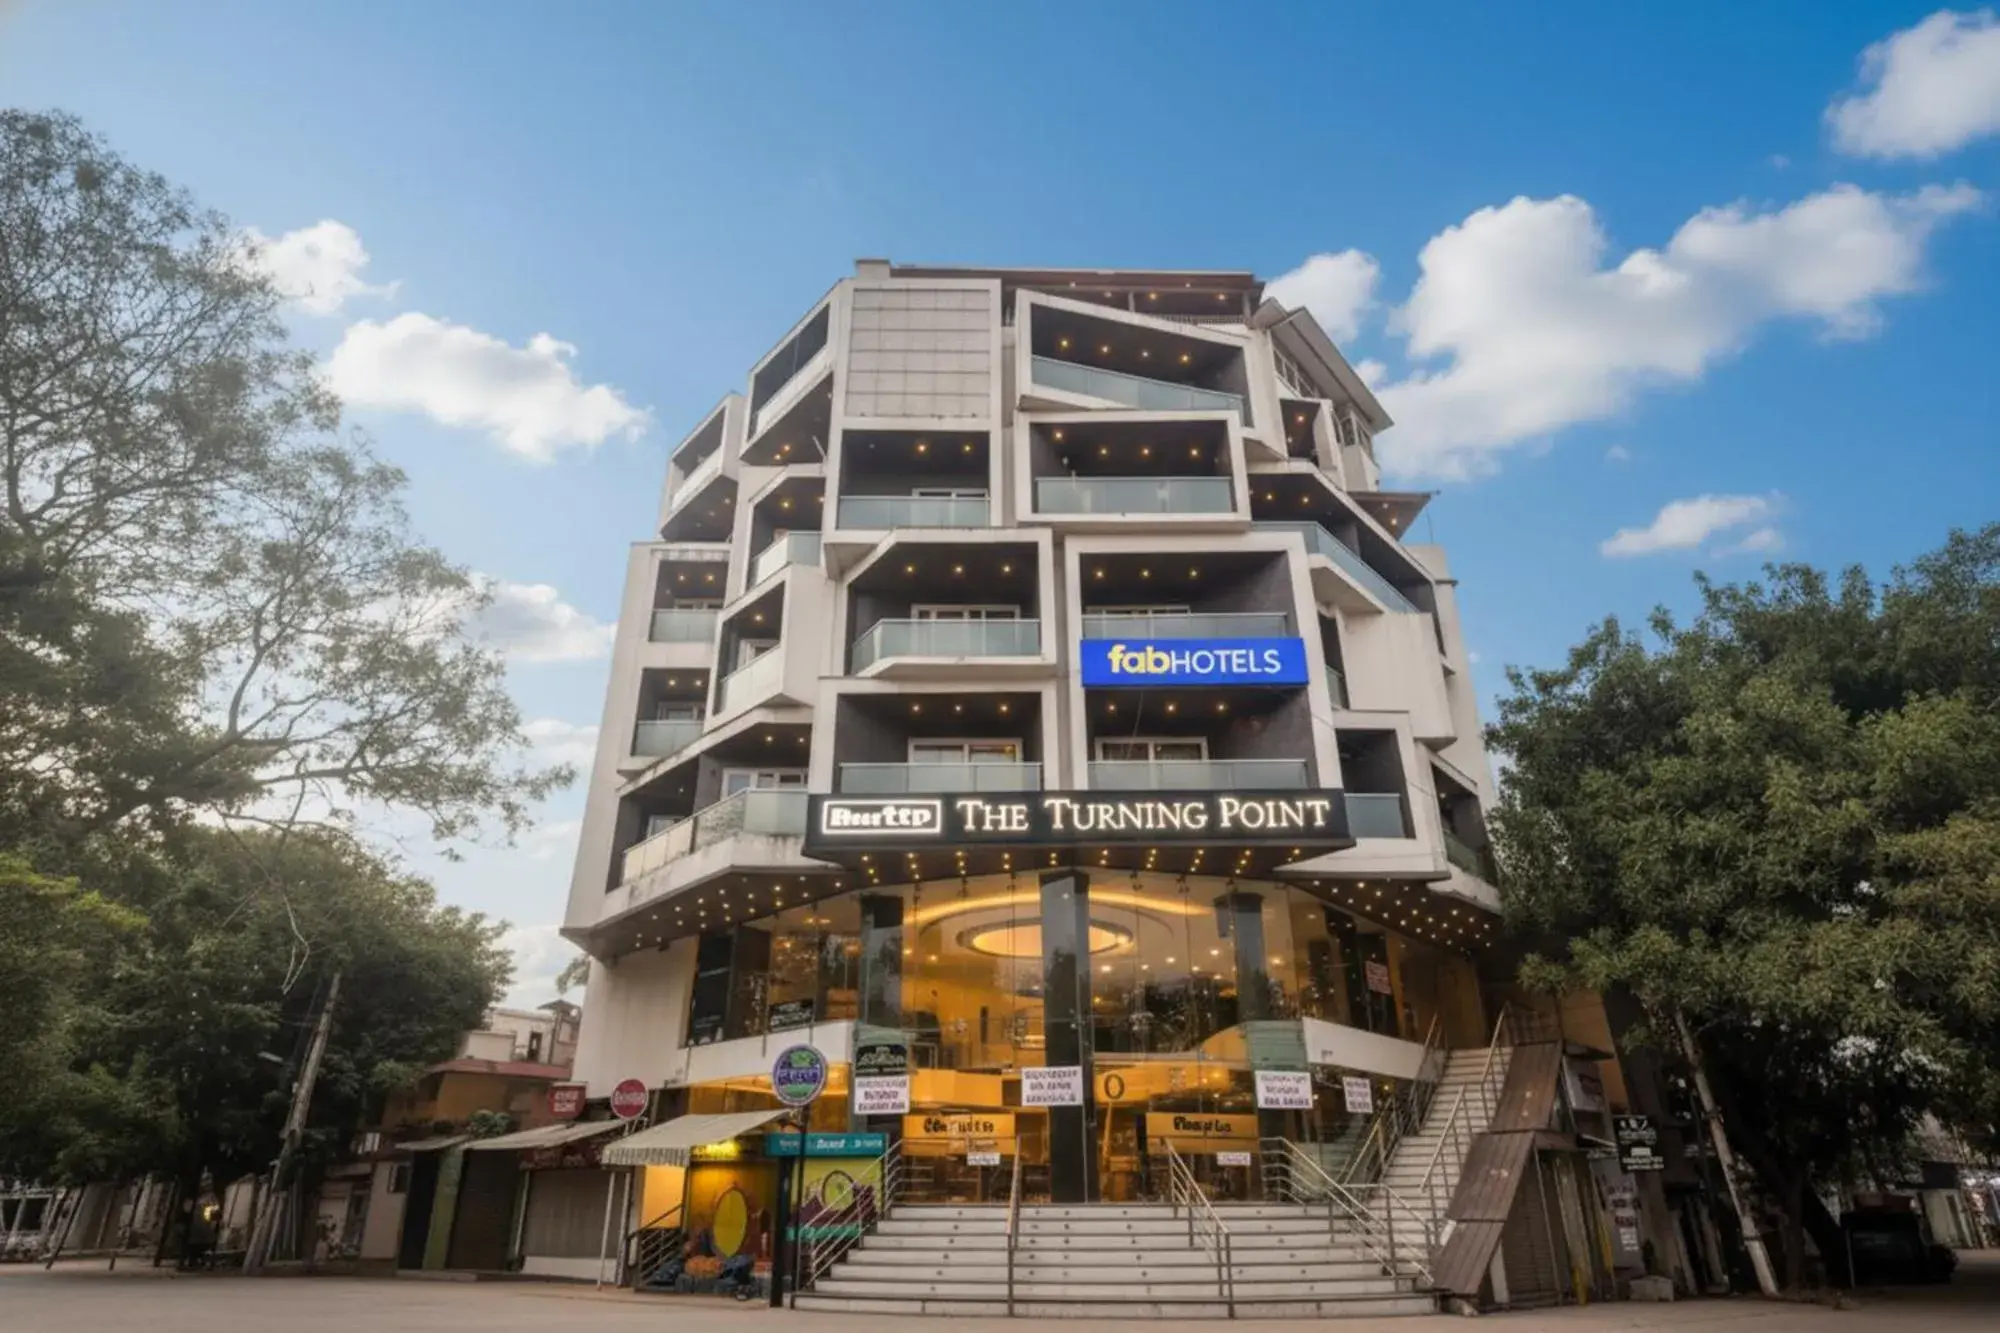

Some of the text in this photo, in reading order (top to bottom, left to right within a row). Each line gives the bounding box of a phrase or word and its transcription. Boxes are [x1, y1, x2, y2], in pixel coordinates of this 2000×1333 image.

[1107, 643, 1281, 674] fabHOTELS
[956, 799, 1030, 832] THE
[1043, 797, 1209, 831] TURNING
[1219, 797, 1331, 829] POINT
